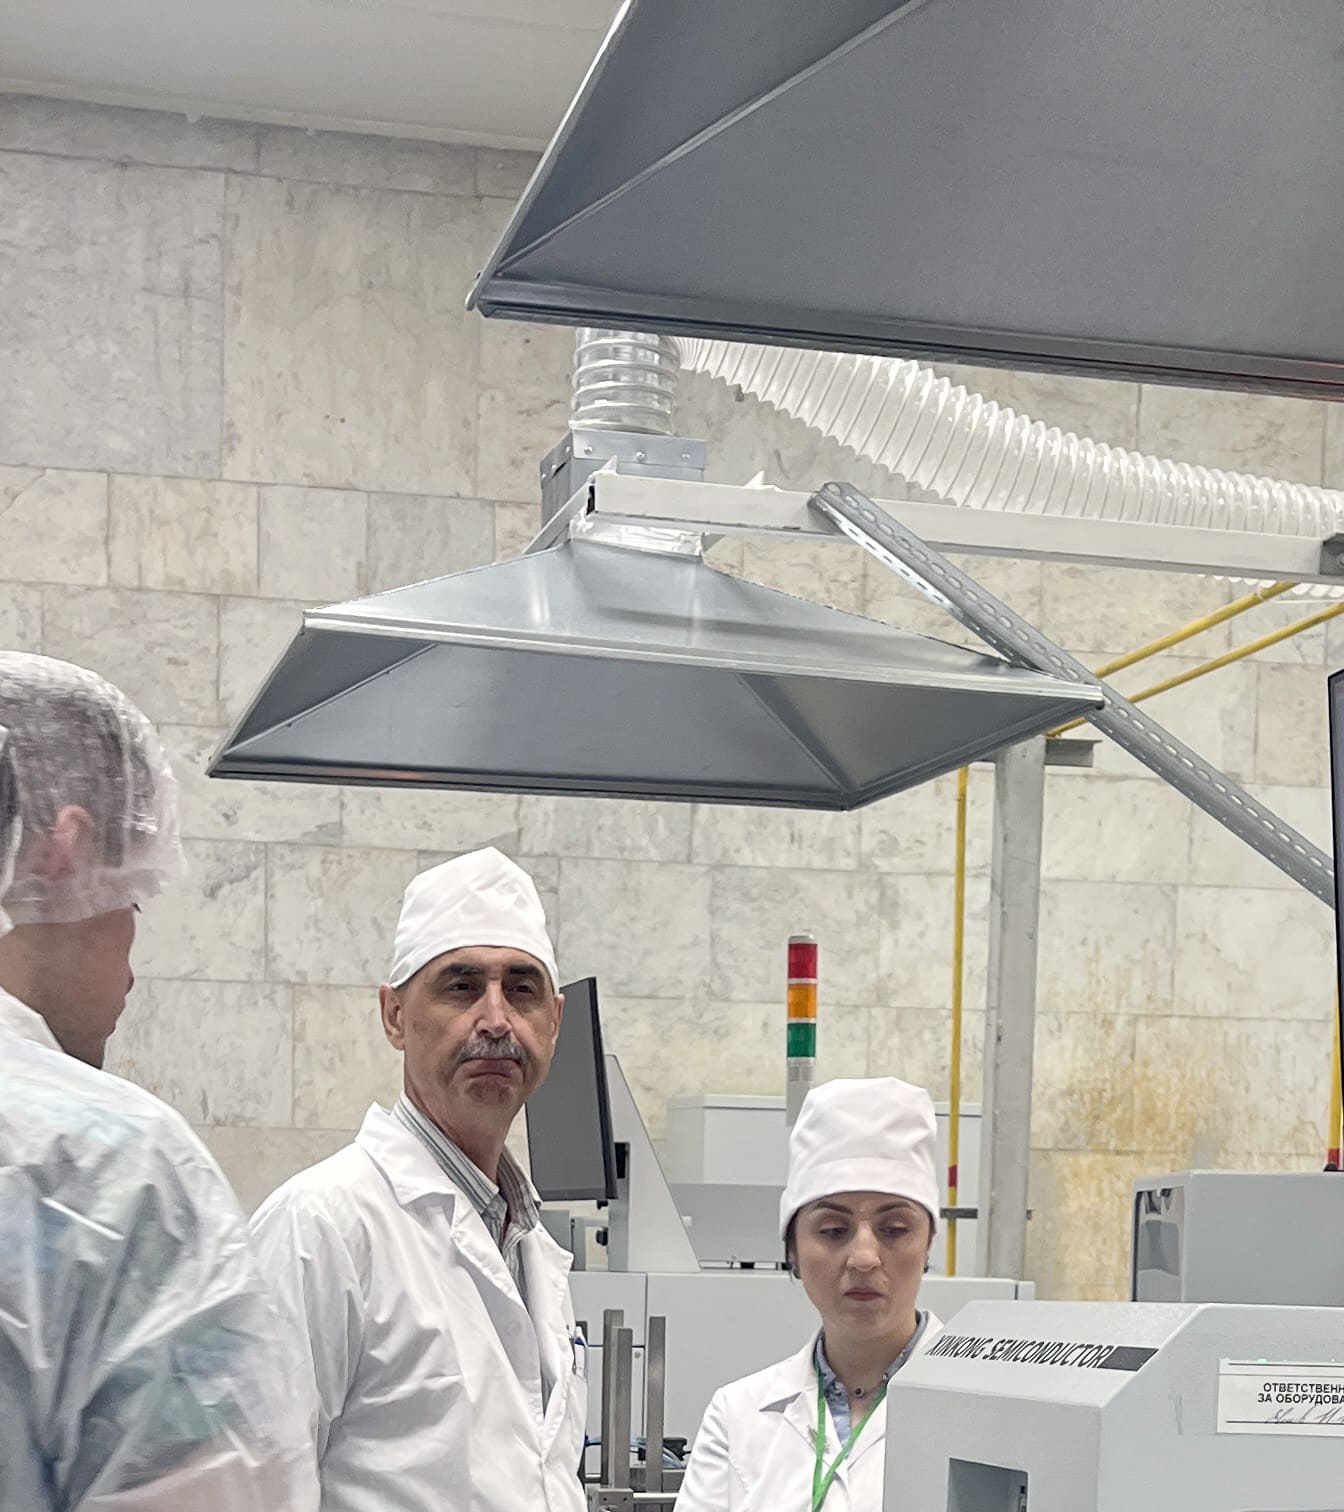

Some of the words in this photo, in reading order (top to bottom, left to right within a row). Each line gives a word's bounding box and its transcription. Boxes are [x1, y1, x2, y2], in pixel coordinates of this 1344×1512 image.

[924, 1335, 994, 1360] XINKONG
[982, 1338, 1114, 1369] SEMICONDUCTOR
[1257, 1393, 1272, 1403] ЗА
